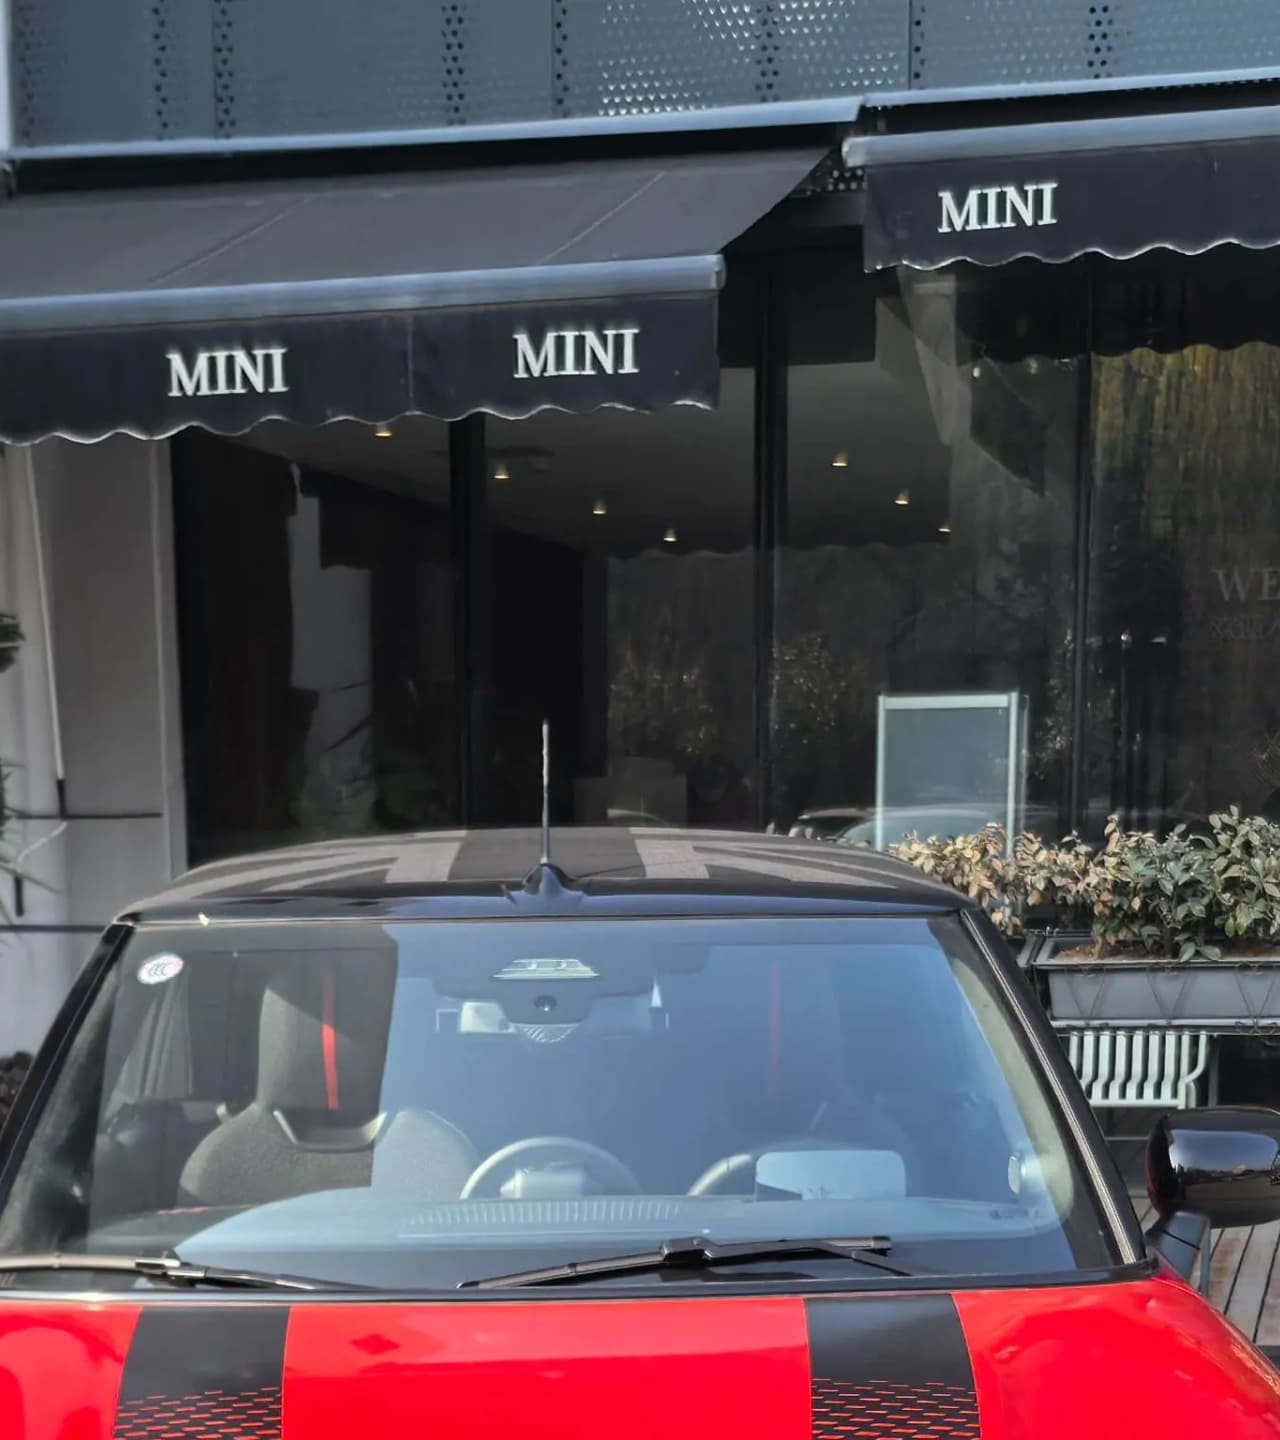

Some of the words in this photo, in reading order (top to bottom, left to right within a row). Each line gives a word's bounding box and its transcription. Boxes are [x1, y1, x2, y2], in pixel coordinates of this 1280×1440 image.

[937, 182, 1058, 233] MINI
[166, 348, 288, 397] MINI
[513, 327, 640, 379] MINI
